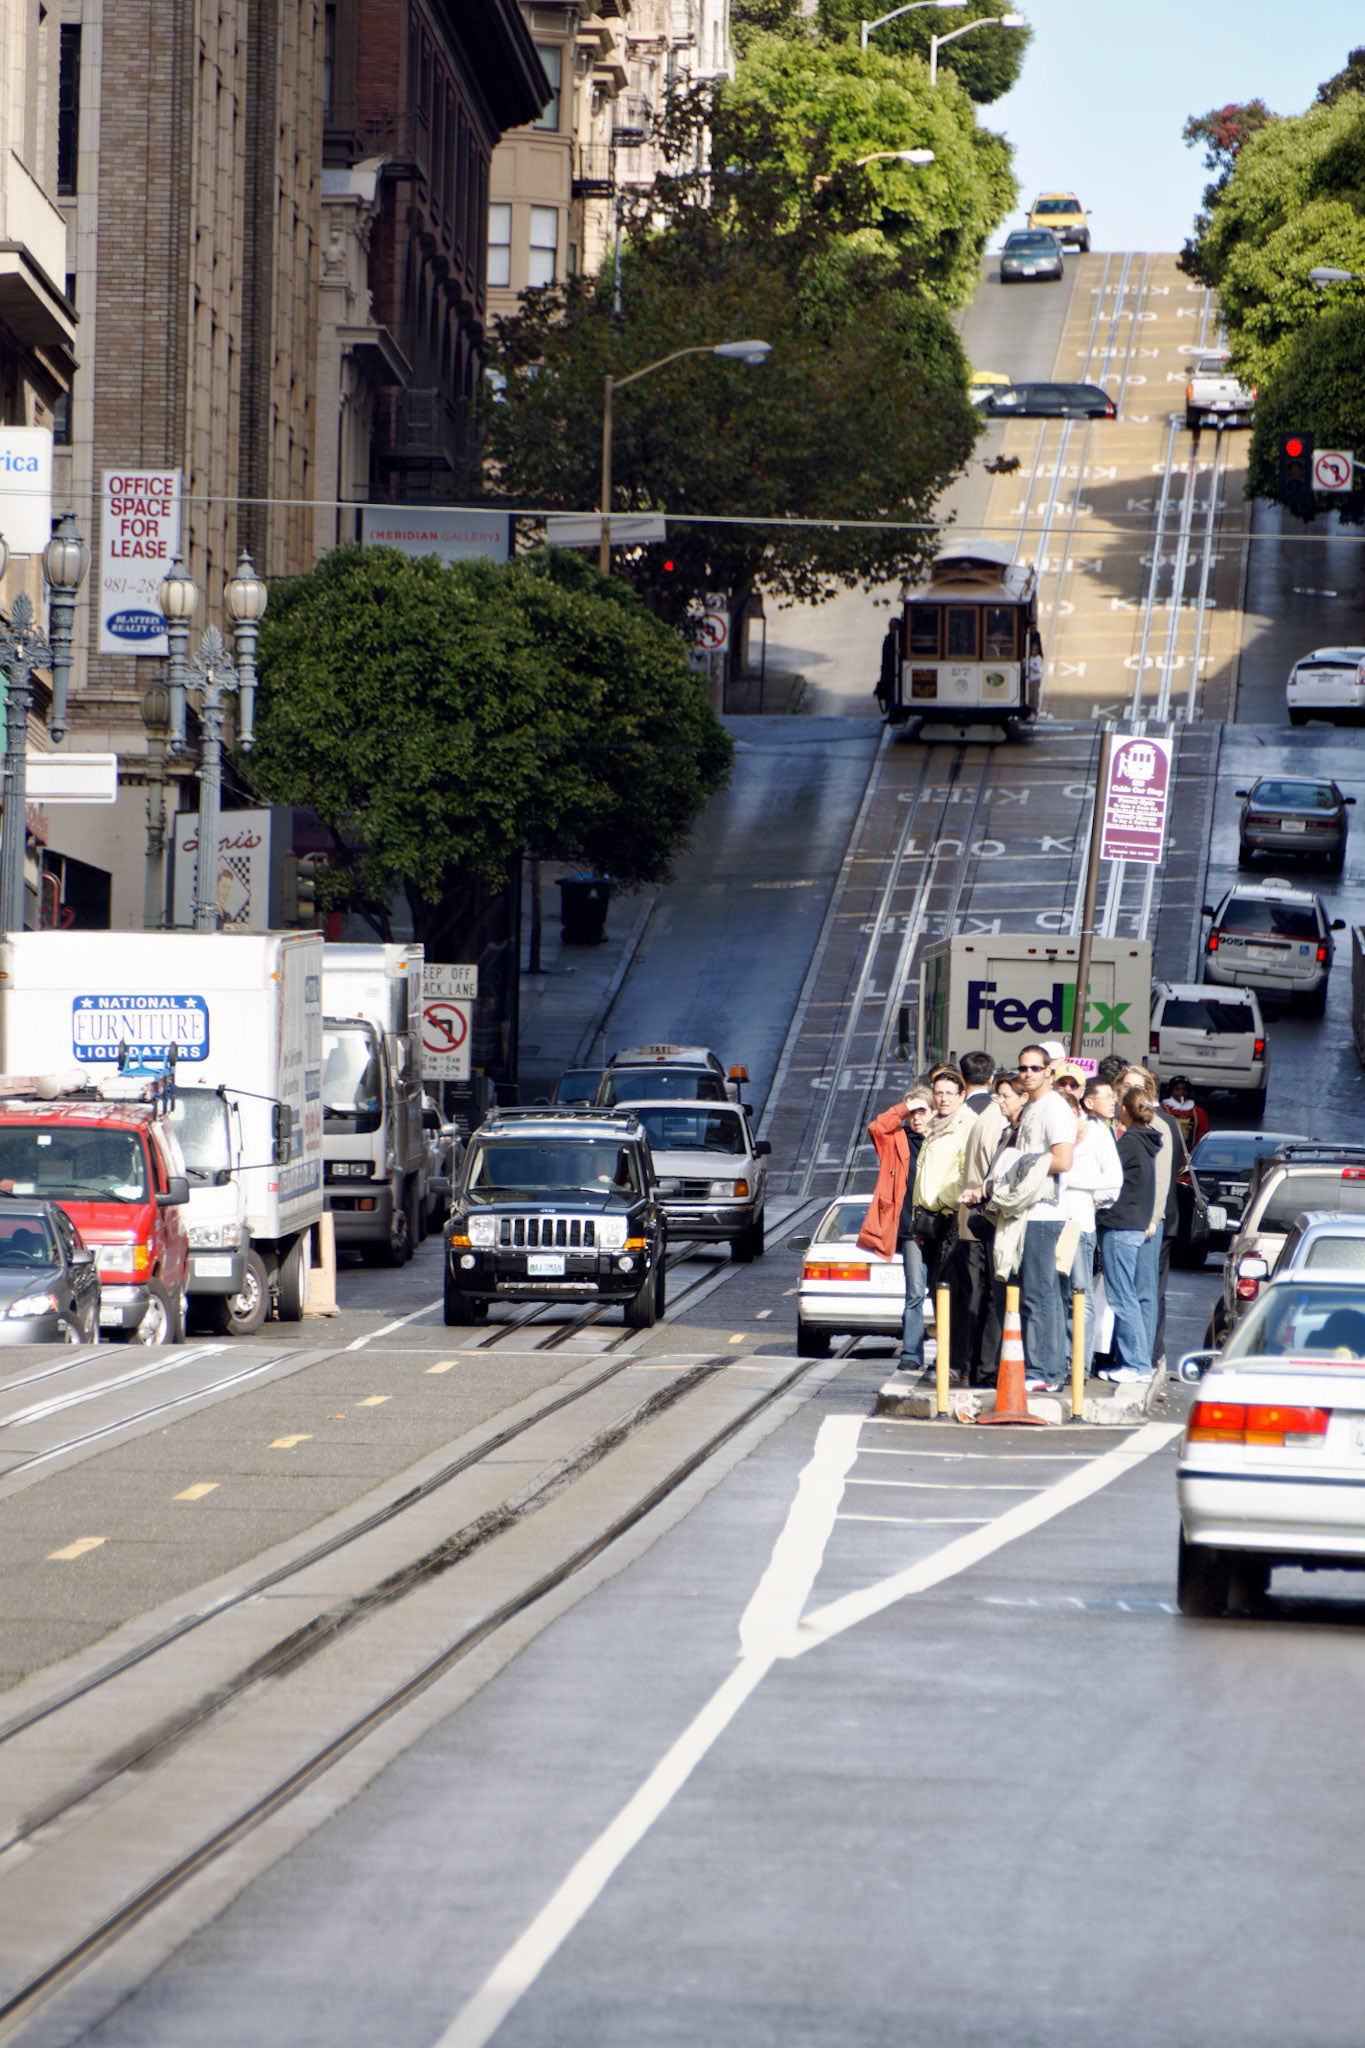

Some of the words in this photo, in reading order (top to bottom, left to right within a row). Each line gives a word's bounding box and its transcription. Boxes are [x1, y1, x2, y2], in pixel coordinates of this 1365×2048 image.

[1091, 311, 1158, 321] OUT
[1018, 465, 1117, 479] KEEP
[1152, 462, 1234, 474] OUT
[109, 476, 173, 496] OFFICE
[110, 497, 171, 517] SPACE
[1010, 501, 1094, 515] OUT
[1126, 499, 1226, 512] KEEP
[121, 518, 159, 537] FOR
[111, 540, 168, 559] LEASE
[1110, 597, 1217, 611] KEEP
[111, 623, 148, 633] REALTY
[1123, 655, 1215, 671] OUT
[1091, 704, 1204, 721] KEEP
[897, 787, 1030, 805] KEEP
[893, 838, 1006, 857] OUT
[859, 914, 1000, 935] KEEP
[1220, 938, 1245, 946] 9015
[424, 966, 443, 980] EEP
[451, 967, 471, 980] OFF
[448, 982, 475, 997] LANE
[98, 997, 179, 1009] NATIONAL
[967, 981, 1132, 1034] FedEx
[77, 1013, 203, 1041] FURNITURE
[1063, 1035, 1104, 1048] Gund
[649, 1046, 672, 1055] TAXI
